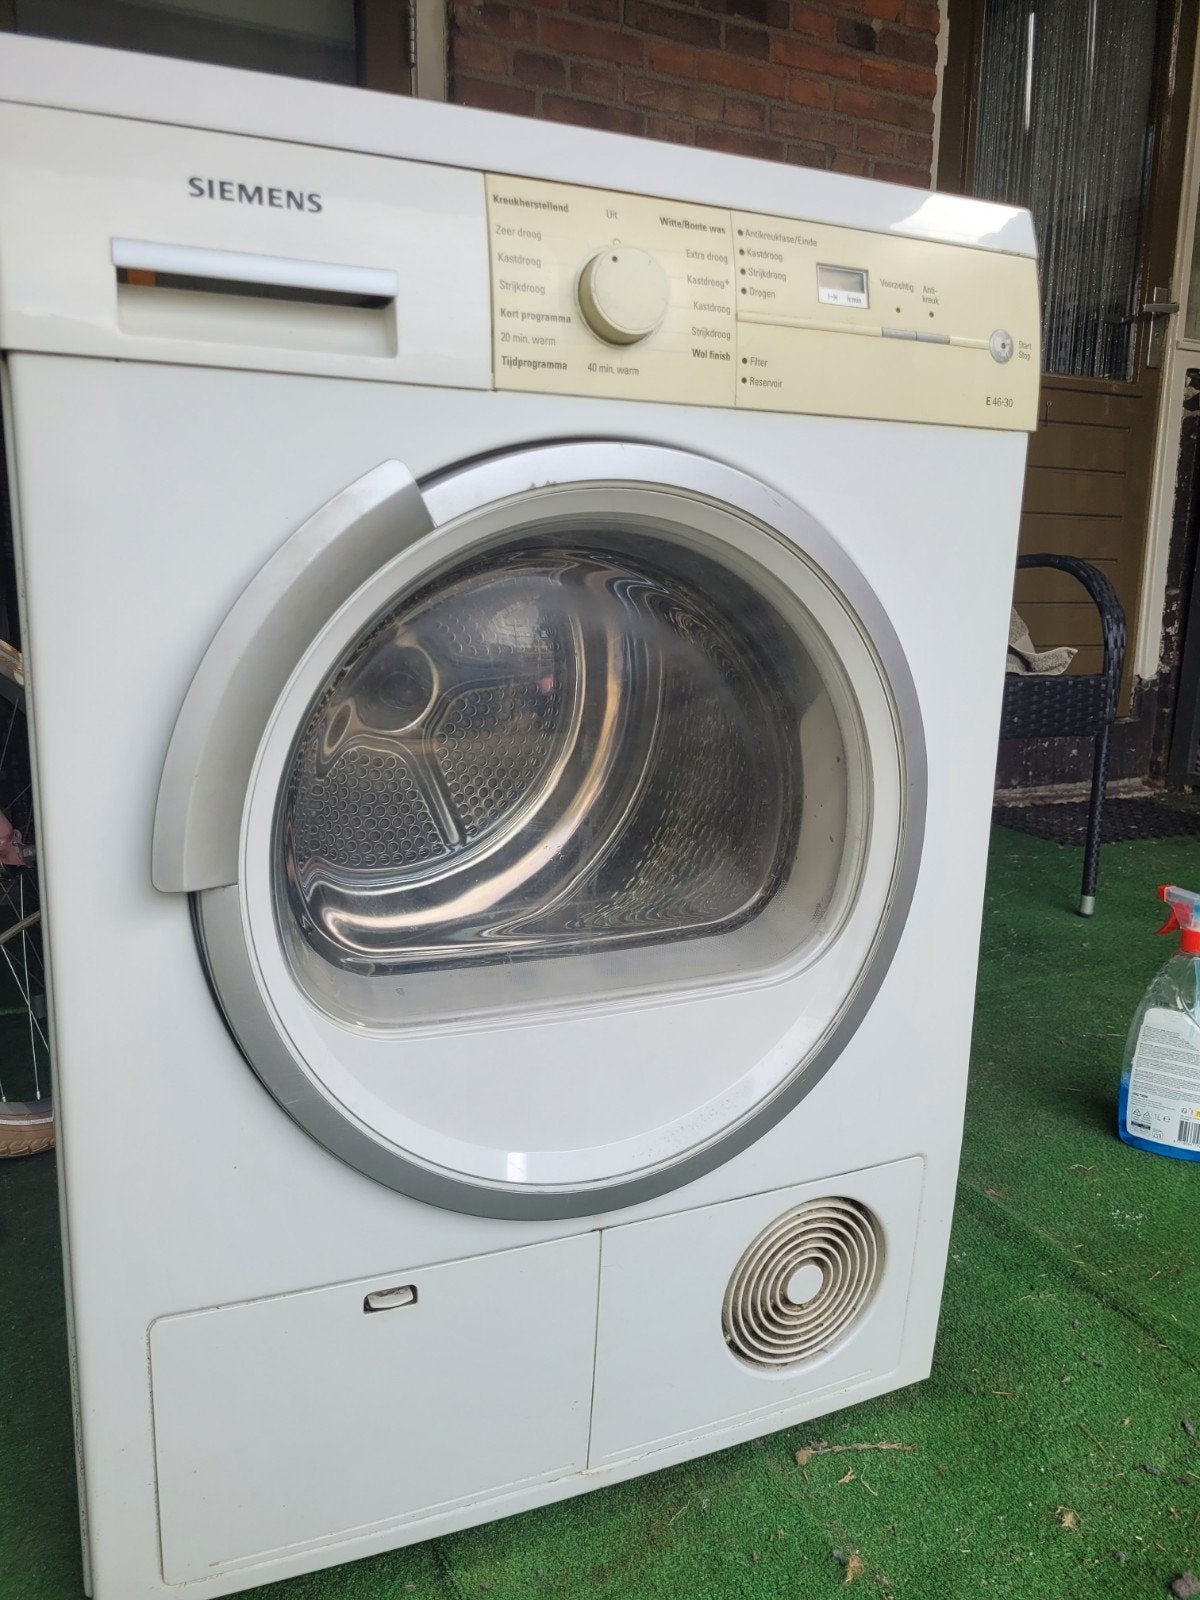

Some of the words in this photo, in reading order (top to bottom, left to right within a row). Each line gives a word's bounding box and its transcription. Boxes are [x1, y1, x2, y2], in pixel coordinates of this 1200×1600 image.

[188, 177, 323, 213] SIEMENS
[493, 194, 569, 213] Kreukherstellend
[606, 209, 618, 220] Uit
[495, 225, 515, 237] Zeer
[518, 228, 542, 241] droog
[660, 216, 707, 232] Witte/Bonte
[709, 226, 726, 235] was
[498, 252, 542, 268] Kastdroog
[686, 249, 704, 260] Extra
[706, 251, 728, 264] droog
[747, 248, 783, 263] Kastdroog
[687, 274, 730, 289] Kastdroog+
[748, 267, 787, 282] Strijkdroog
[499, 280, 545, 295] Strijkdroog
[880, 278, 914, 293] Voorzichtig
[749, 287, 776, 300] Drogen
[500, 308, 519, 319] Kort
[521, 311, 571, 323] programma
[693, 301, 731, 315] Kastdroog
[501, 333, 511, 342] 20
[513, 334, 530, 344] min.
[532, 337, 556, 346] warm
[691, 327, 731, 341] Strijkdroog
[1018, 341, 1032, 350] Start
[692, 349, 707, 359] Wol
[709, 350, 731, 361] finish
[750, 356, 768, 367] Filter
[501, 356, 568, 371] Tijdprogramma
[588, 363, 597, 373] 40
[599, 364, 615, 375] min.
[617, 367, 639, 376] warm
[749, 376, 783, 388] Reservoir
[986, 396, 991, 406] E
[992, 397, 1014, 408] 46-30
